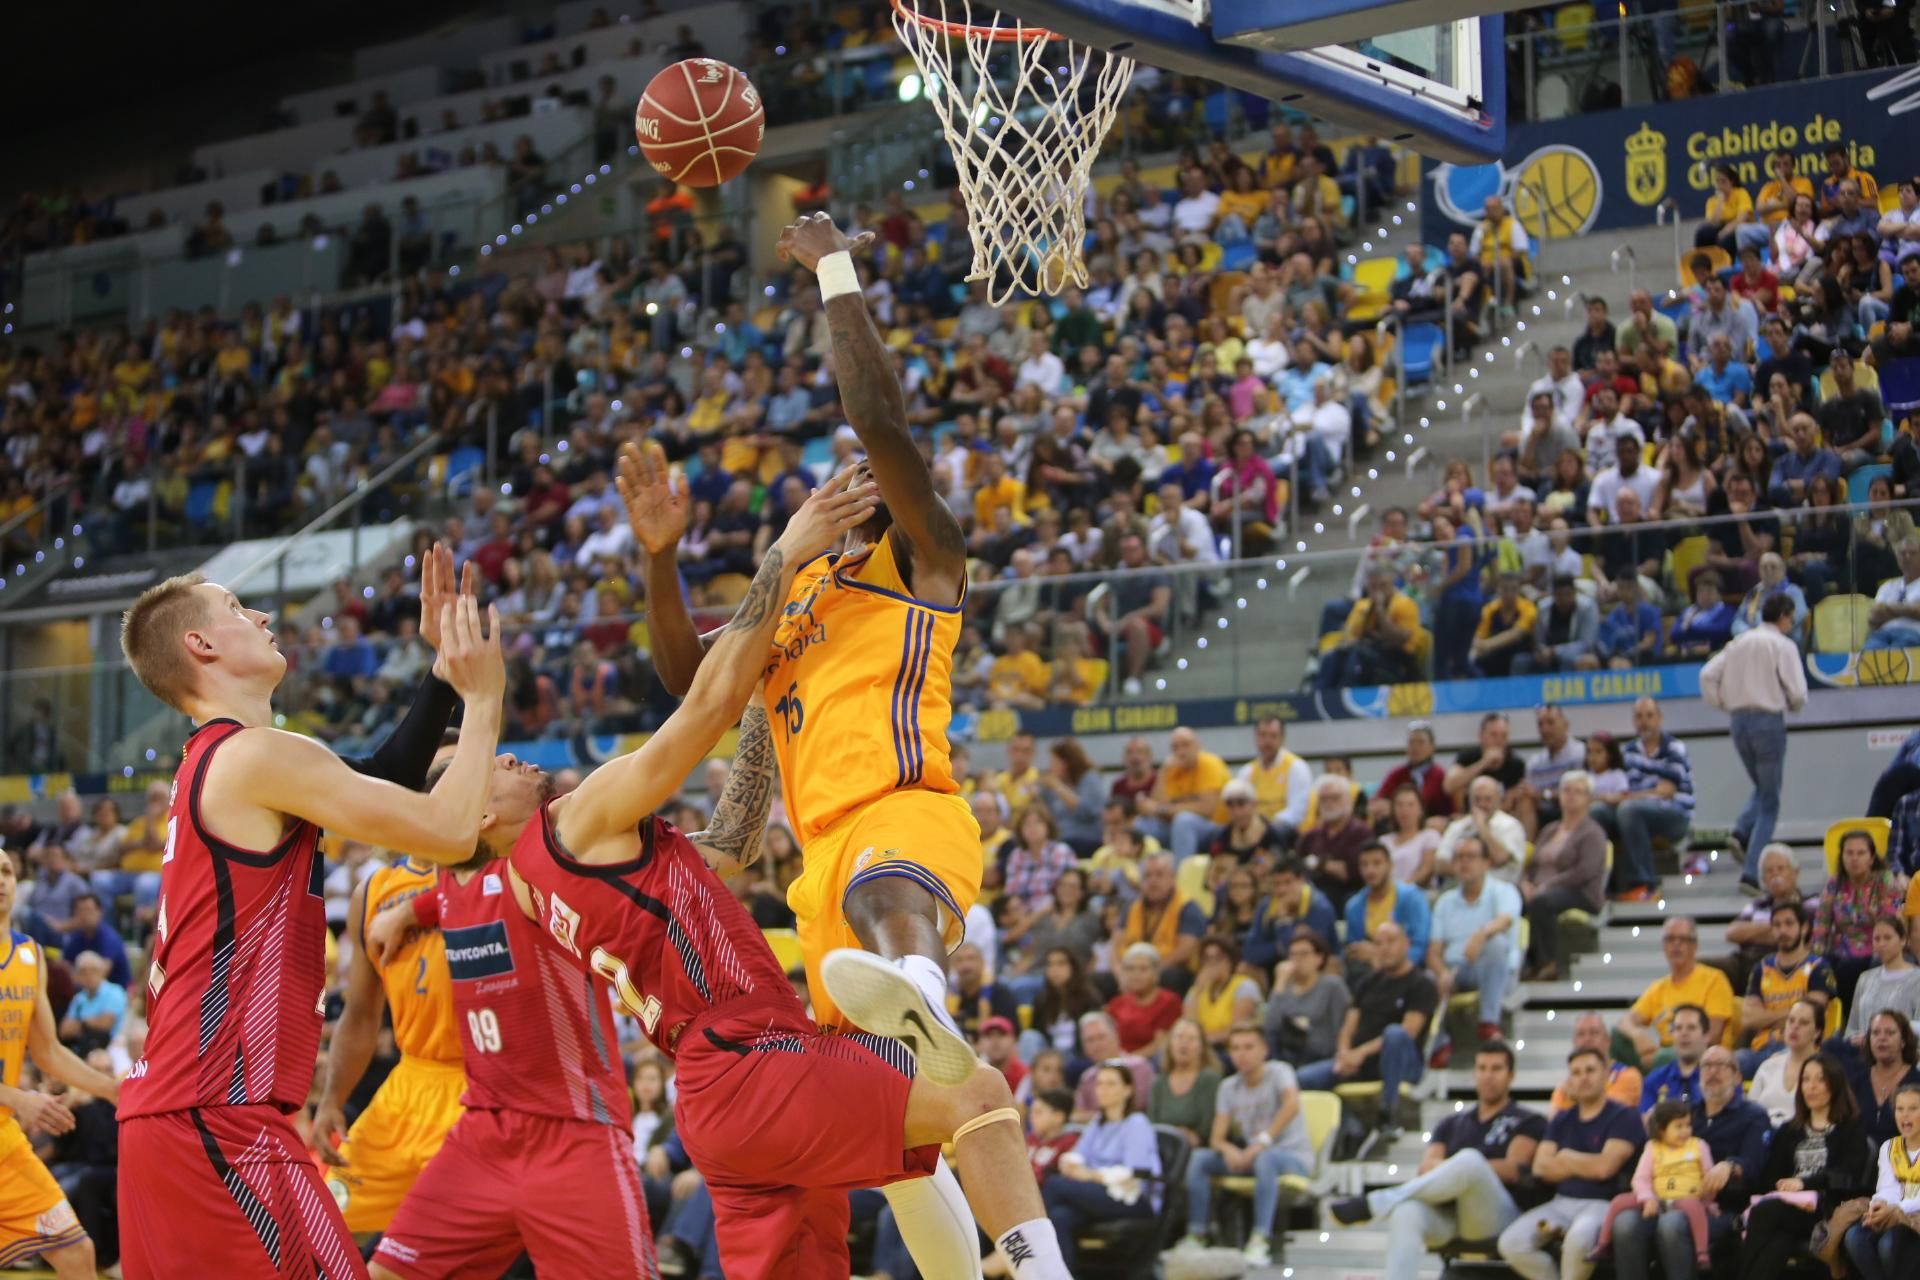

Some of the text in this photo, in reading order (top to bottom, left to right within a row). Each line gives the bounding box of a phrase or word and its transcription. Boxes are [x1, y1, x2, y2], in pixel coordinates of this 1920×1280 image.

[1686, 113, 1841, 160] Cabildo de
[1687, 158, 1757, 190] Grn
[1542, 670, 1662, 703] GRAN CANARIA
[774, 681, 805, 744] 15
[467, 1008, 503, 1054] 89
[1000, 1229, 1034, 1270] PEAK
